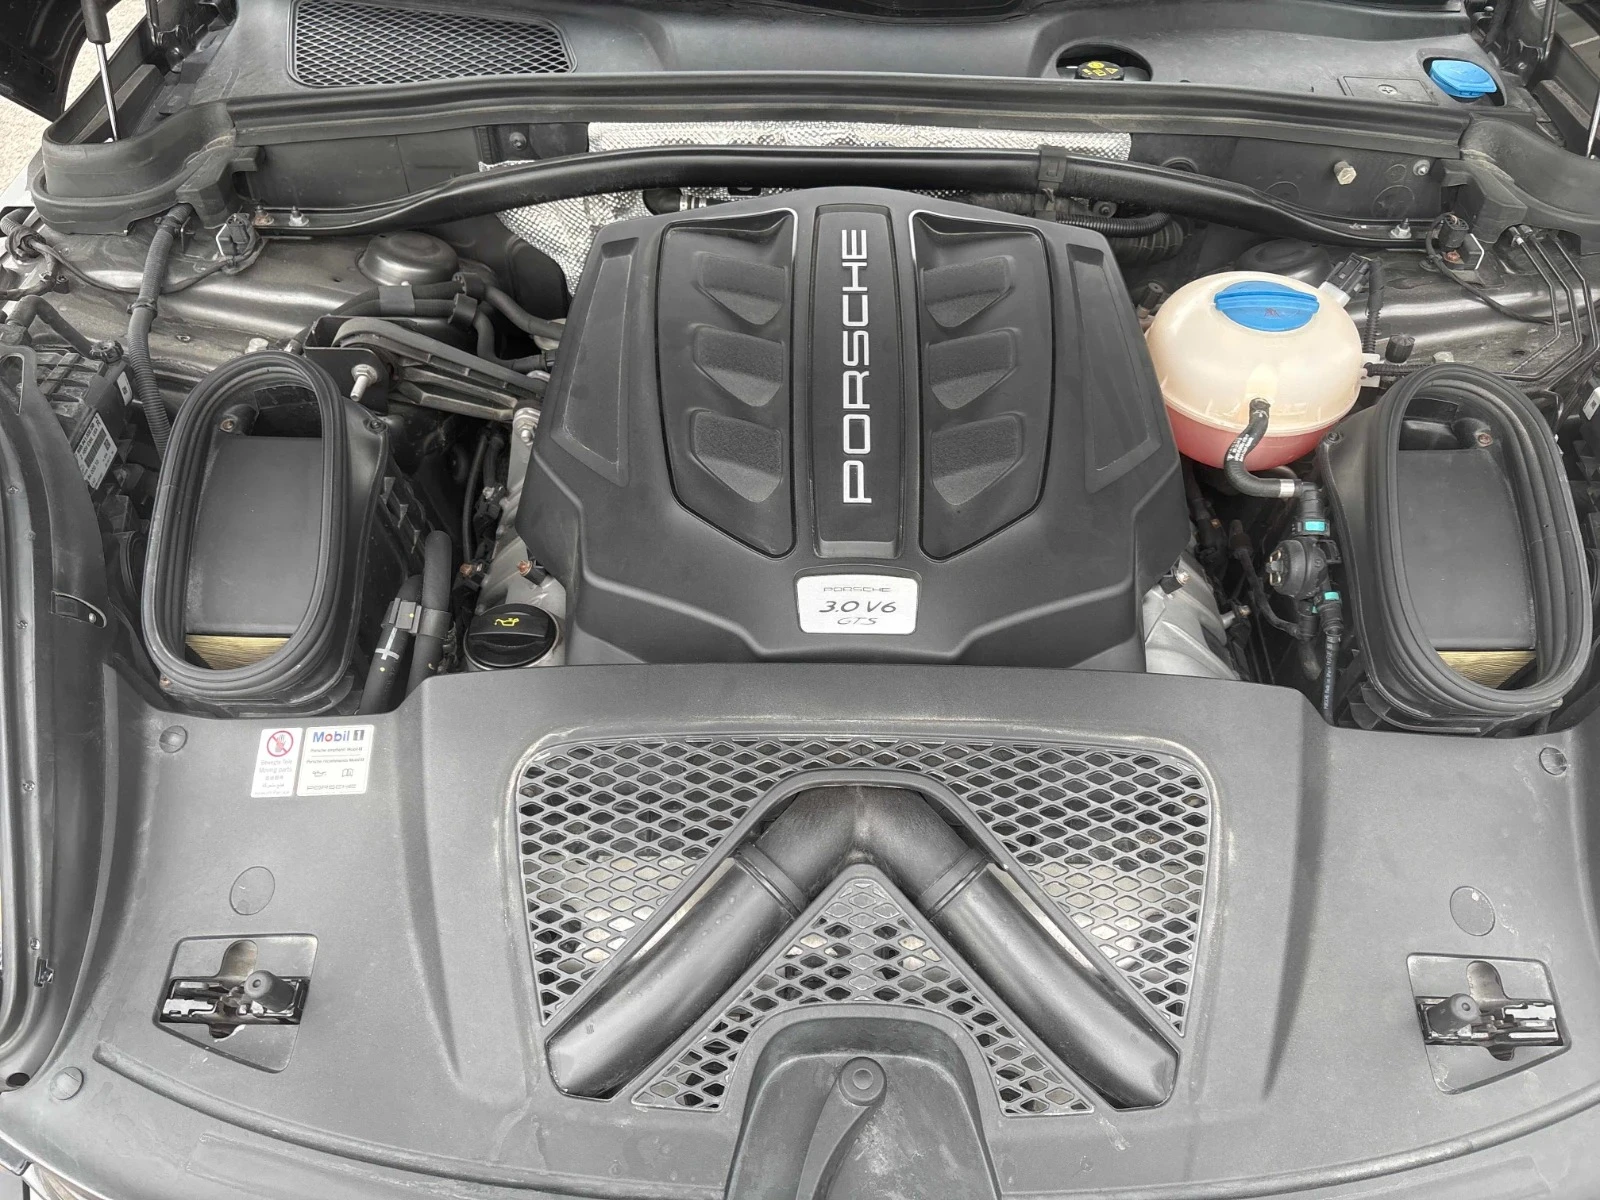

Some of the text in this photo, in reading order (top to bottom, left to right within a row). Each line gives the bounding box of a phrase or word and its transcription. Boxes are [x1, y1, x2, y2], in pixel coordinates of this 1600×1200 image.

[841, 229, 872, 504] PORSCHE
[818, 600, 897, 613] 3.0 V6
[837, 617, 878, 625] GTS
[312, 730, 350, 742] Mobil
